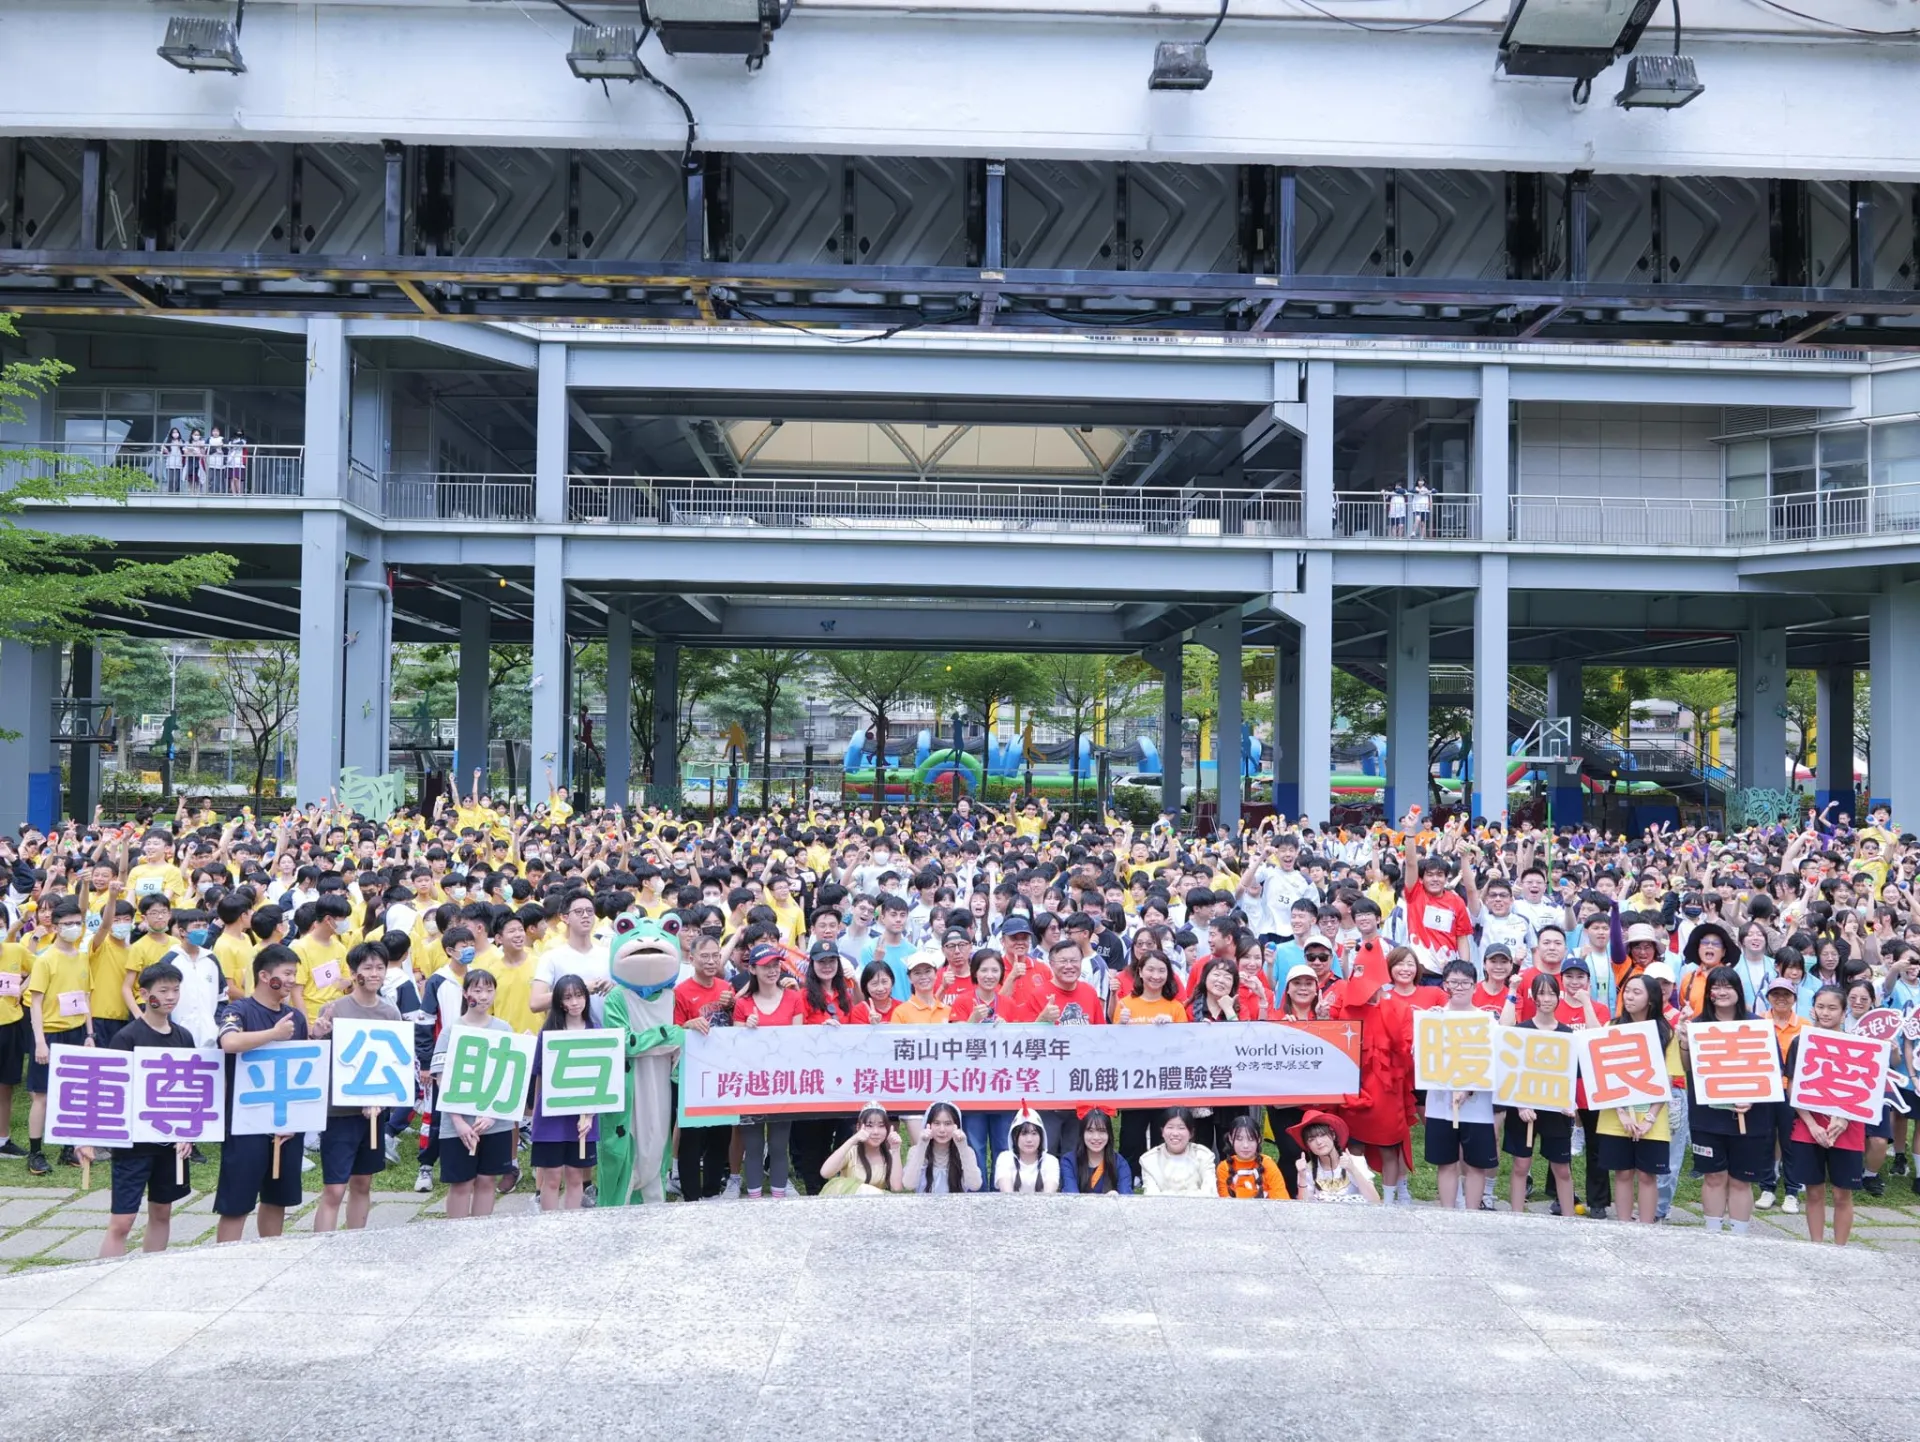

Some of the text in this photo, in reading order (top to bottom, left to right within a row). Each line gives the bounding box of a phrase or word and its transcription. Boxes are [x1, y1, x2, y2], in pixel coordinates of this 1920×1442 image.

[88, 919, 100, 928] 40
[1278, 895, 1290, 905] 33
[325, 970, 332, 979] 6
[1504, 937, 1516, 946] 29
[72, 999, 78, 1007] 1
[340, 1030, 412, 1102] 公
[442, 1035, 527, 1114] 助
[547, 1038, 618, 1108] 互
[894, 1039, 1071, 1061] 南山中學114學年
[1235, 1044, 1324, 1056] World Vision
[1421, 1018, 1492, 1089] 暖
[1498, 1033, 1570, 1107] 溫
[1591, 1030, 1666, 1103] 良
[1694, 1025, 1775, 1099] 善
[1799, 1035, 1882, 1118] 愛
[52, 1055, 131, 1140] 重
[139, 1053, 219, 1138] 尊
[239, 1047, 322, 1127] 平
